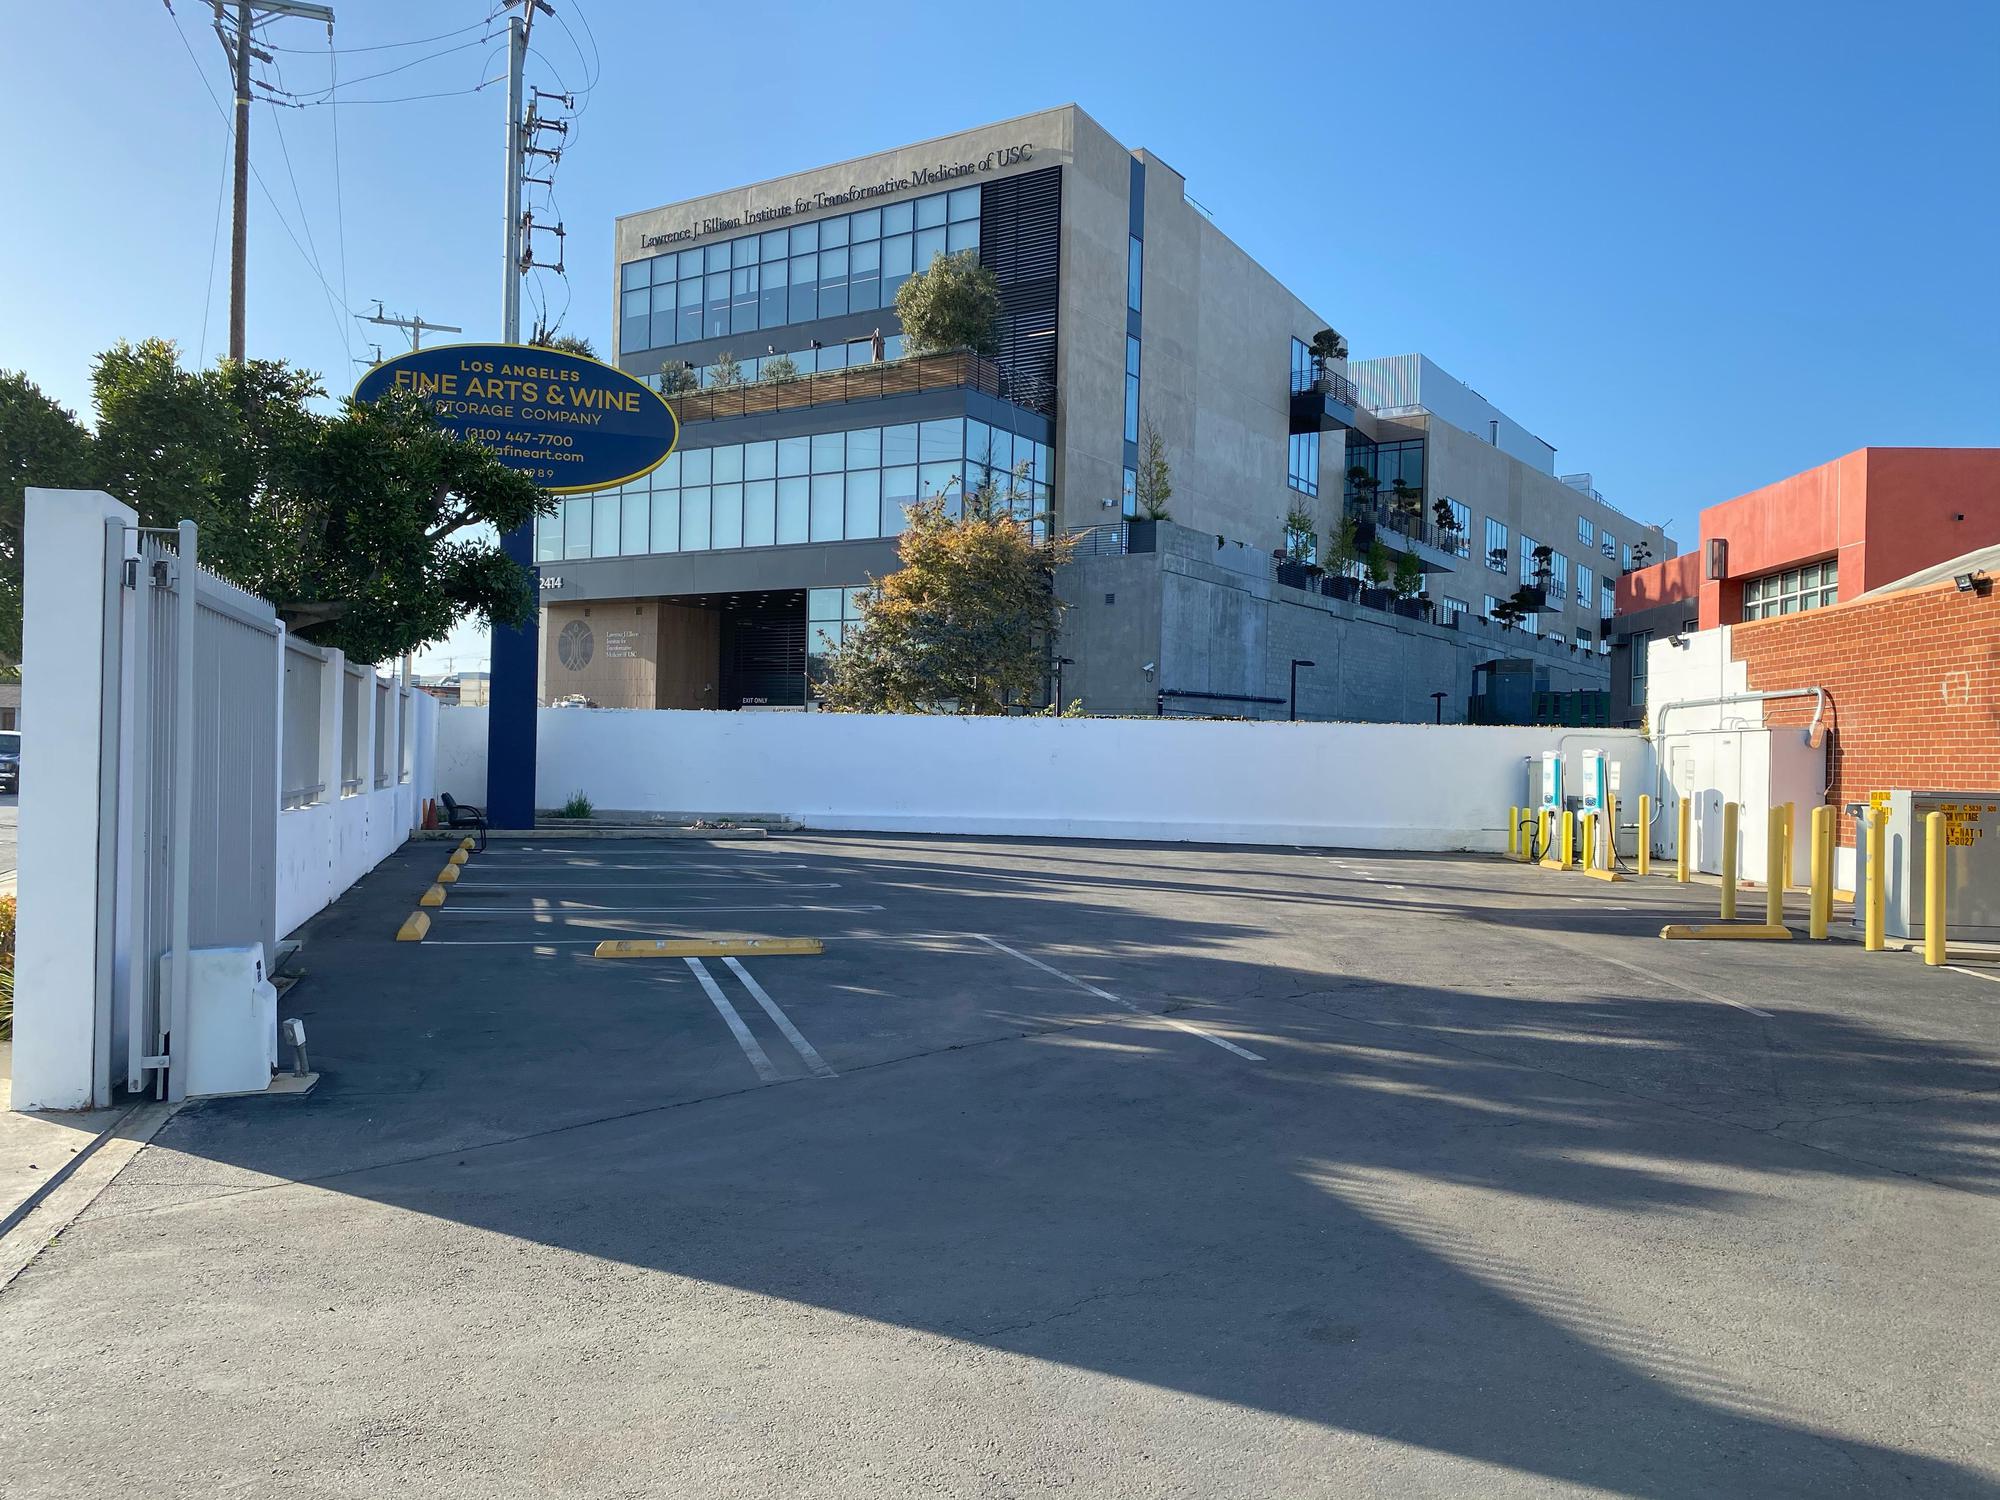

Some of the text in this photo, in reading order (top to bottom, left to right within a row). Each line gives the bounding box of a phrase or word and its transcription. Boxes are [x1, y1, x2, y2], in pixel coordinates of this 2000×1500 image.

[641, 143, 1033, 249] Lawrence J. Ellison Institute for Transformative Medicine of USC
[461, 360, 580, 382] LOS ANGELES
[395, 369, 640, 413] FINE ARTS & WINE
[436, 399, 602, 425] STORAGE COMPANY
[465, 427, 573, 448] (310) 447-7700
[539, 576, 562, 589] 2414
